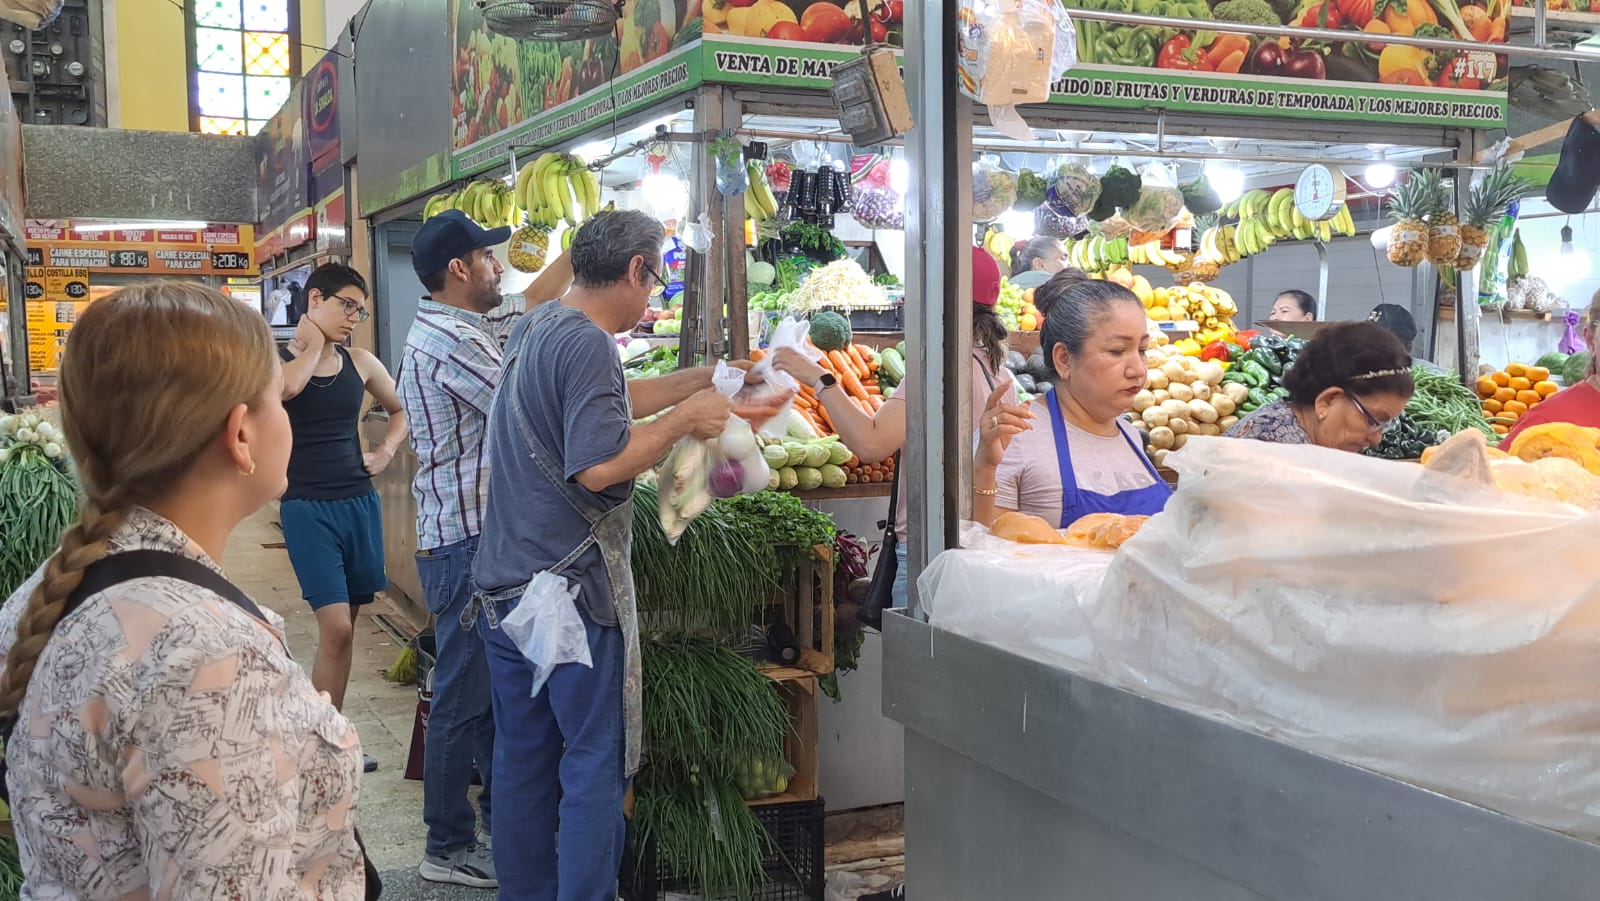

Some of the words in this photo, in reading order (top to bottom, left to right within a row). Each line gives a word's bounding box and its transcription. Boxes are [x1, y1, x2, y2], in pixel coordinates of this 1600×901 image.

[716, 53, 771, 73] VENTA
[776, 58, 798, 75] DE
[802, 60, 839, 77] MAY
[1454, 57, 1496, 83] #117
[633, 75, 659, 99] MEJORES
[1093, 81, 1112, 95] DE
[1116, 83, 1168, 100] FRUTAS
[1172, 86, 1182, 100] Y
[1184, 87, 1254, 105] VERDURAS
[1257, 91, 1275, 106] DE
[1278, 93, 1355, 111] TEMPORADA
[1358, 98, 1367, 111] Y
[1369, 99, 1392, 113] LOS
[1394, 100, 1449, 116] MEJORES
[1452, 103, 1502, 119] PRECIOS.
[50, 249, 73, 257] CARNE
[75, 249, 107, 258] ESPECIAL
[110, 252, 116, 264] $
[138, 256, 148, 267] Kg
[156, 251, 178, 259] CARNE
[179, 251, 210, 260] ESPECIAL
[50, 258, 69, 266] PARA
[165, 260, 182, 268] PARA
[184, 261, 202, 269] ASAR
[218, 254, 237, 268] 208
[238, 257, 248, 269] Kg
[47, 268, 73, 278] COSTILLA
